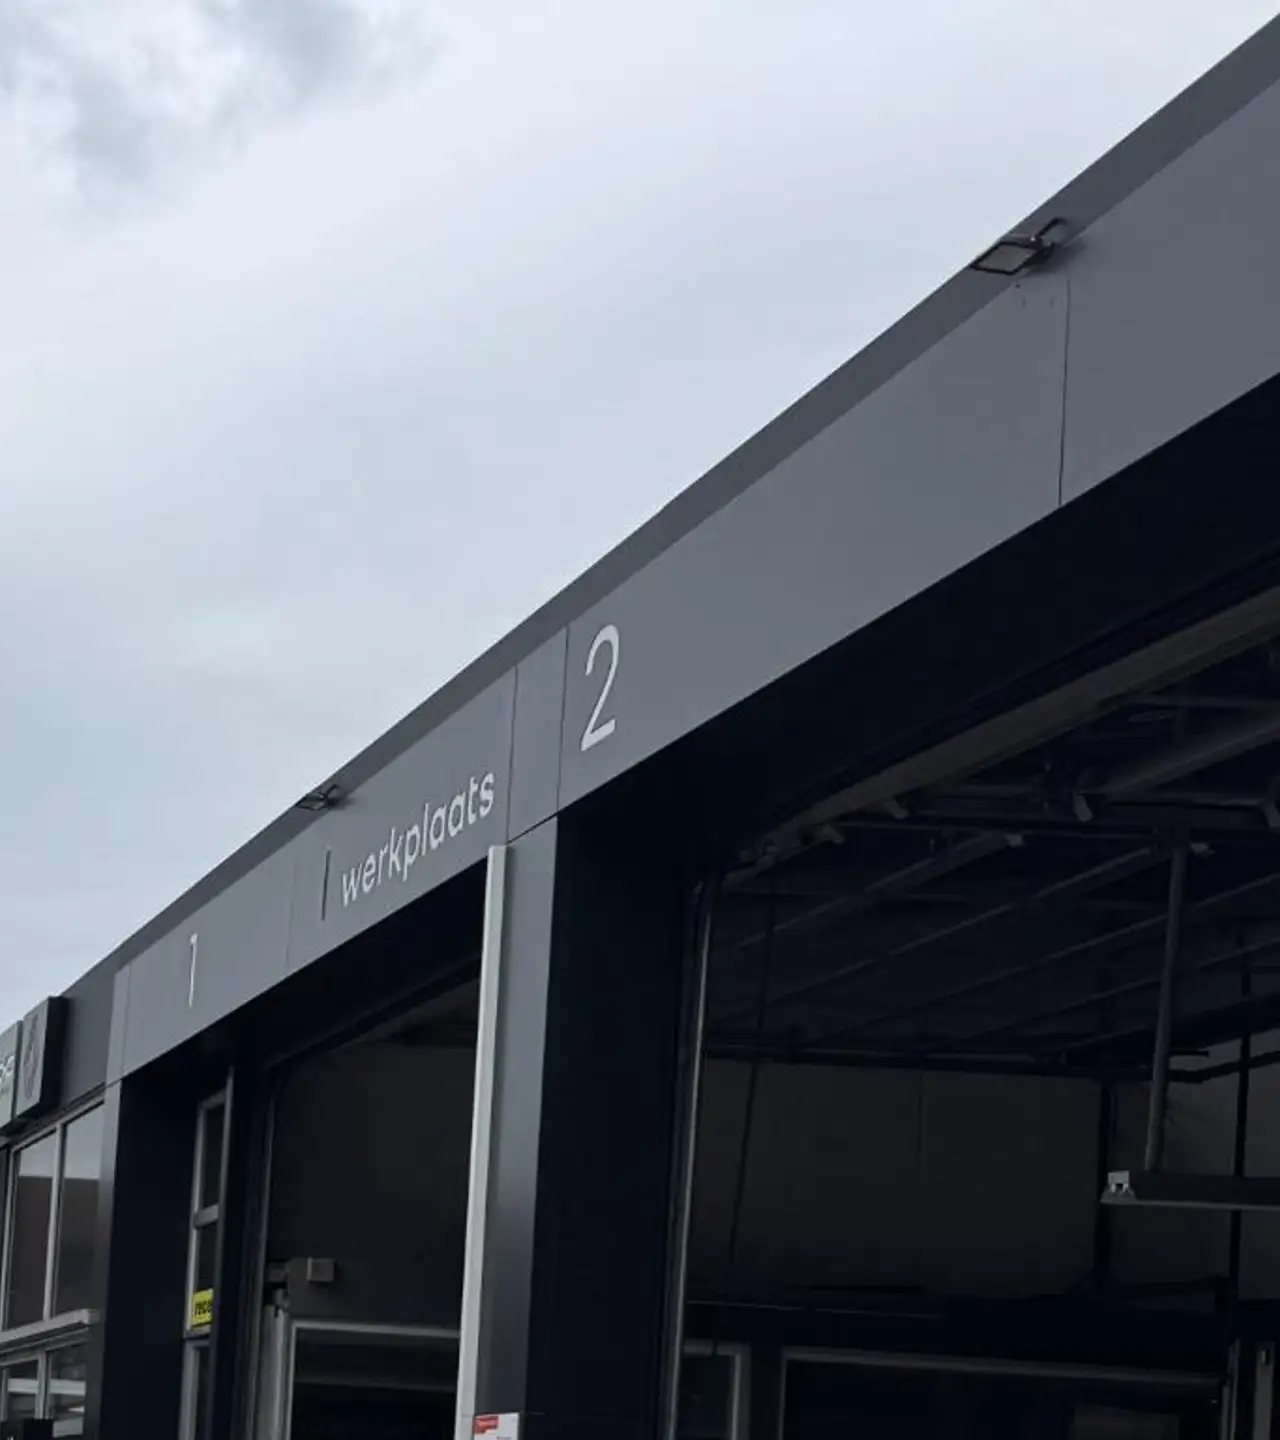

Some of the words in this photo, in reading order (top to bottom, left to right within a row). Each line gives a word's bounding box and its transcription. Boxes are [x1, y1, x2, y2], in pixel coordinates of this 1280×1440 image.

[579, 623, 621, 753] 2
[341, 770, 495, 907] werkplaats
[188, 932, 198, 1008] 1
